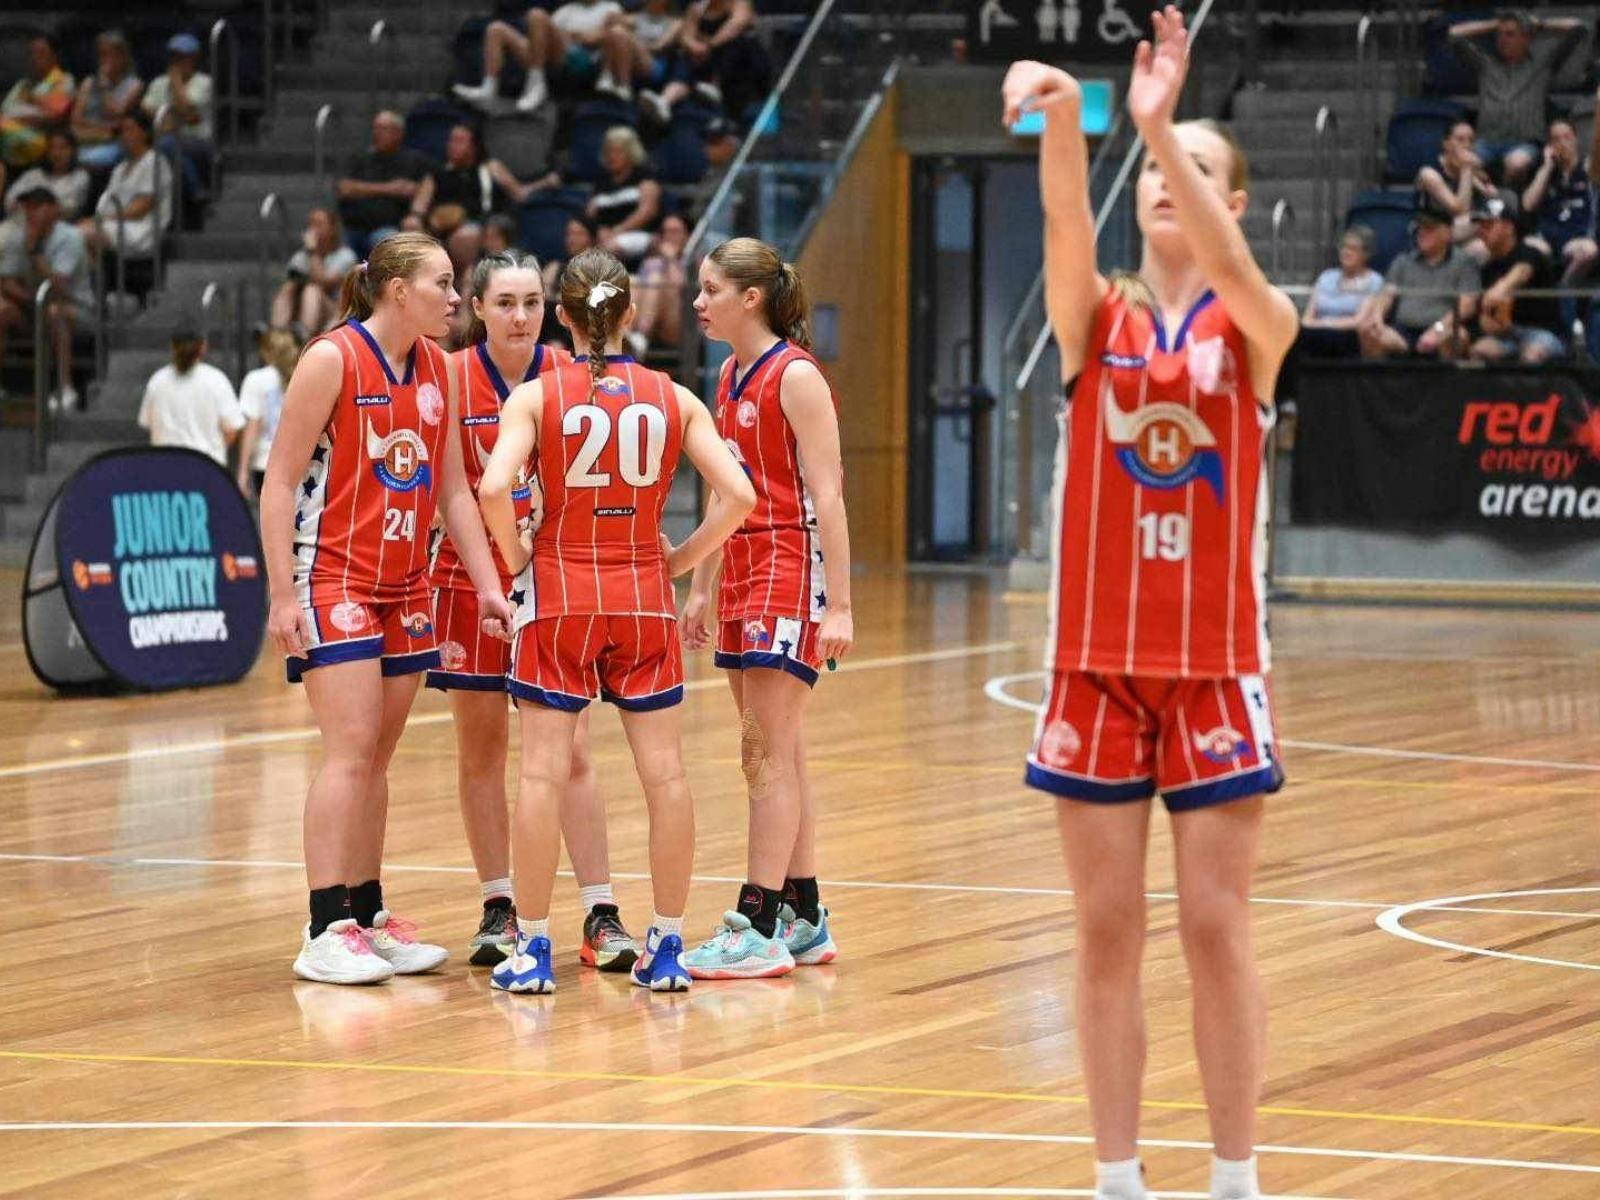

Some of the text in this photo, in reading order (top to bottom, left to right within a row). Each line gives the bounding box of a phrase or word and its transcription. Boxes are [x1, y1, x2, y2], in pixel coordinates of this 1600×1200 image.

[1459, 394, 1562, 445] red
[394, 446, 412, 474] H
[562, 403, 667, 488] 20
[1149, 426, 1180, 466] H
[1480, 448, 1579, 479] energy
[1480, 483, 1600, 518] arena
[111, 491, 210, 558] JUNIOR
[383, 508, 415, 541] 24
[1137, 512, 1190, 562] 19
[120, 557, 216, 613] COUNTRY
